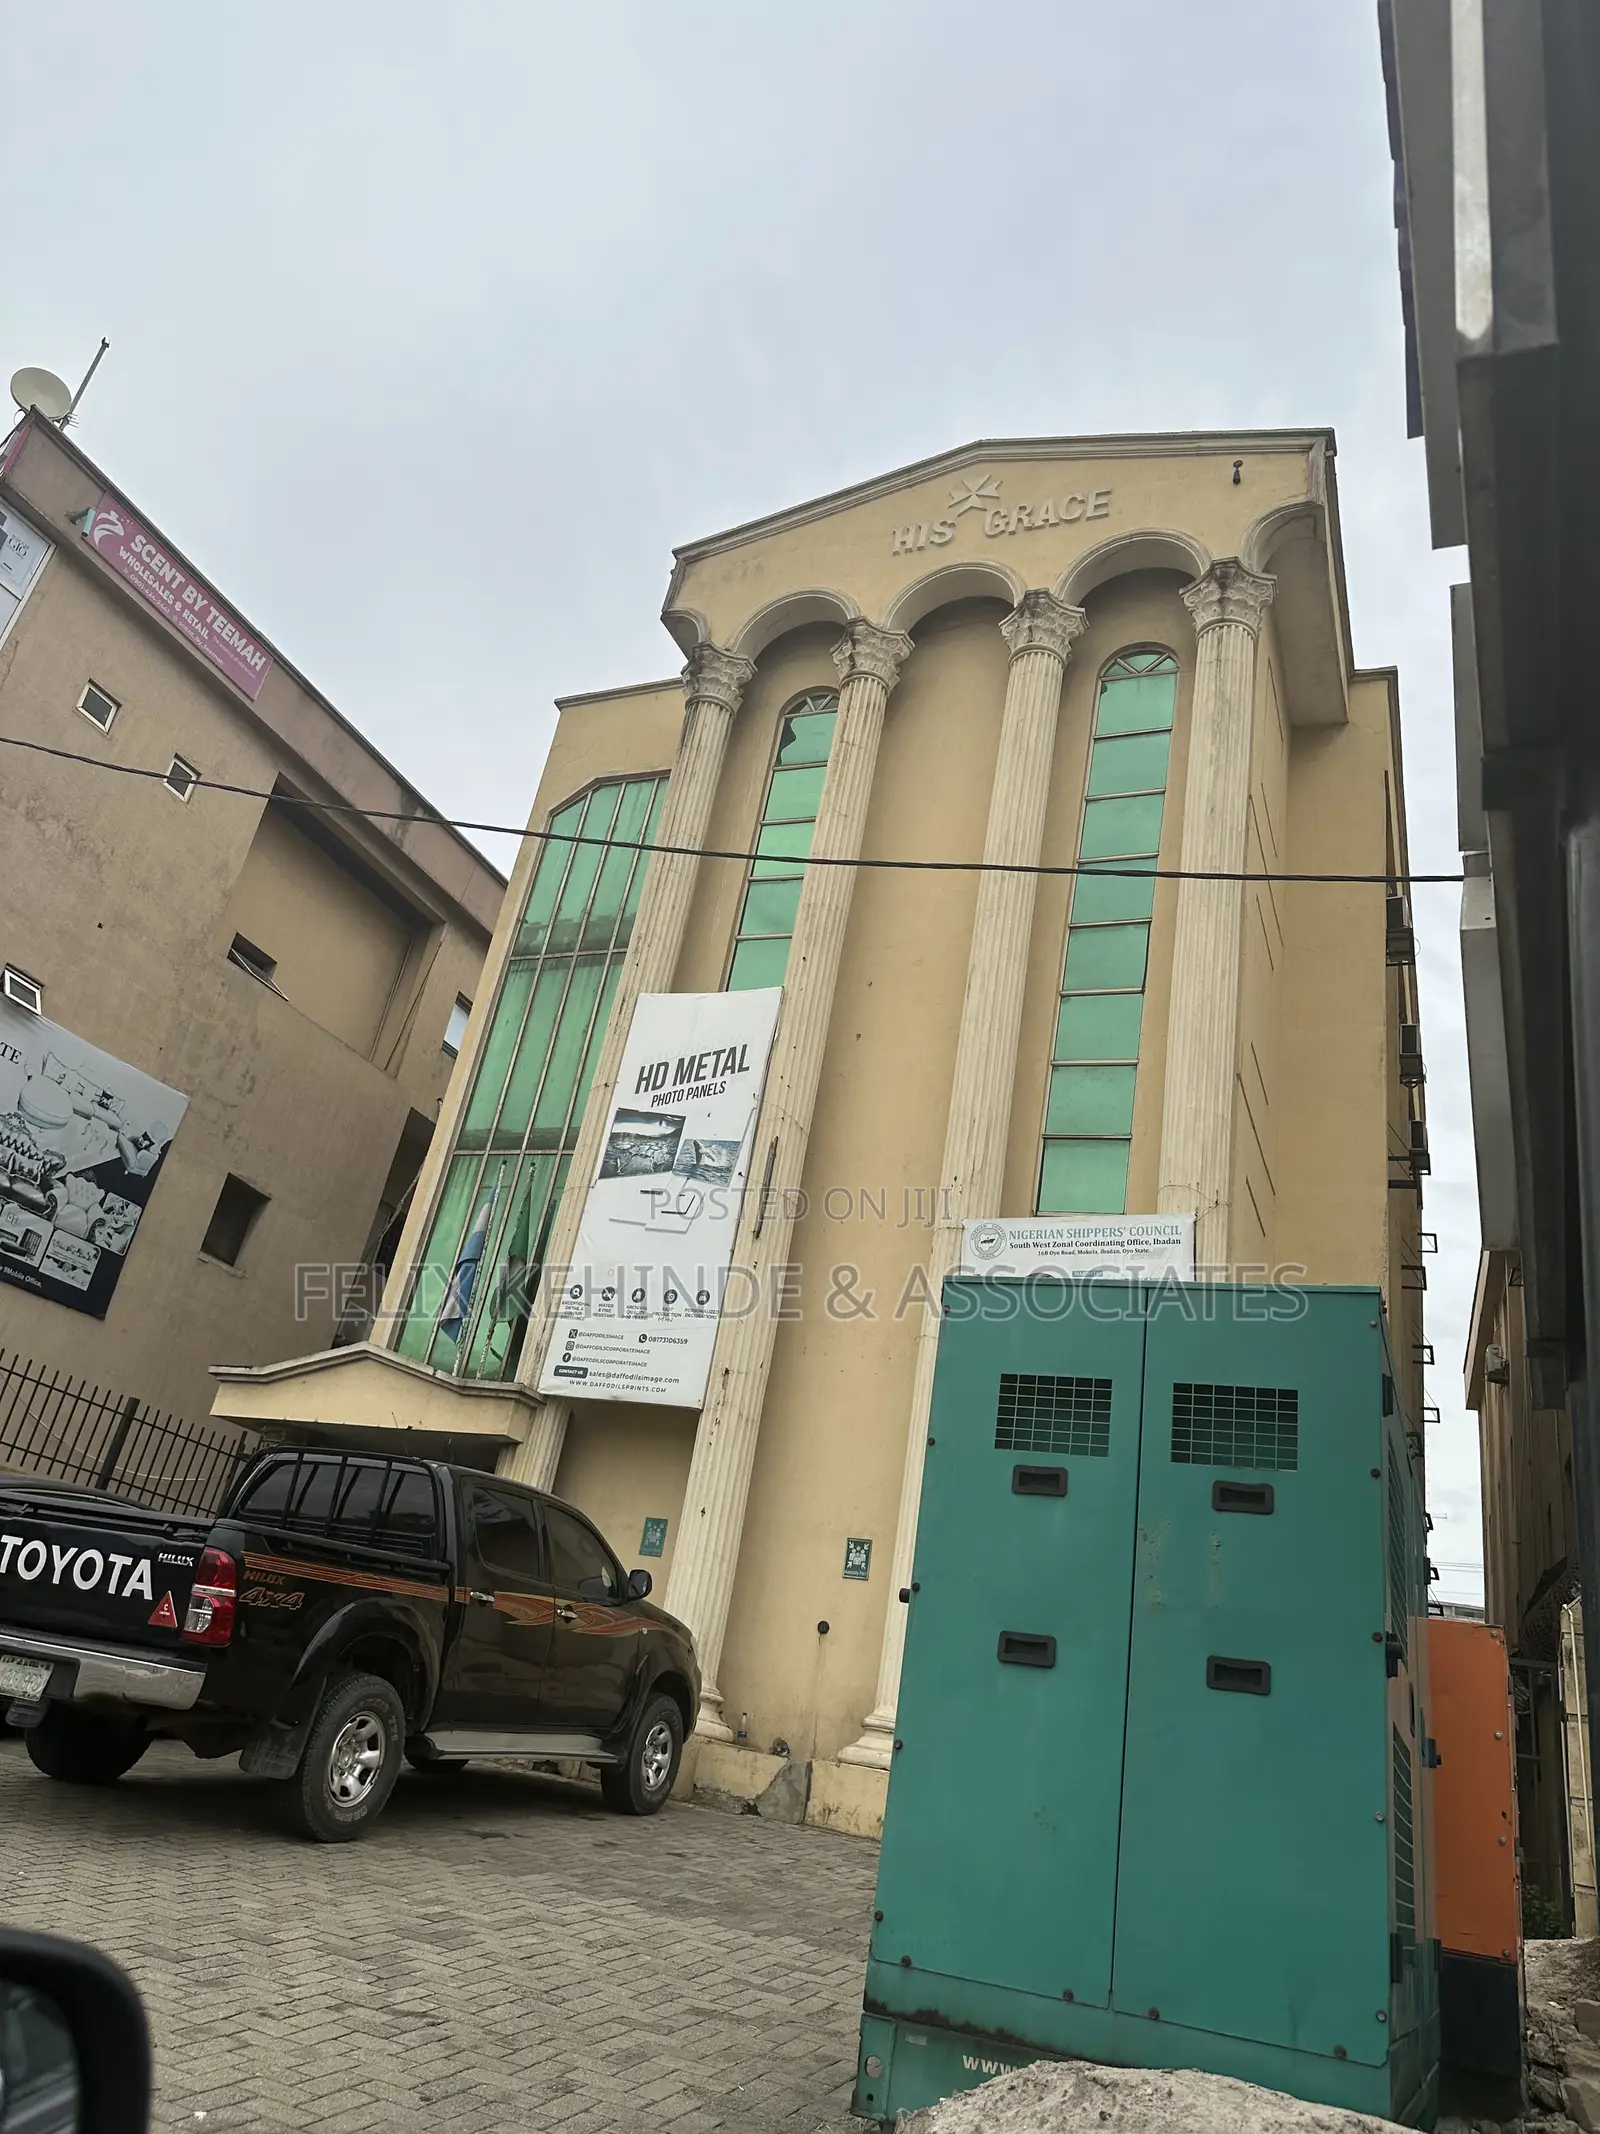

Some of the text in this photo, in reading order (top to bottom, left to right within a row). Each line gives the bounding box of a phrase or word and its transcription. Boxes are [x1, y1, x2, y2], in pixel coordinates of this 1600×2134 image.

[892, 488, 1113, 556] HIS GRACE
[118, 546, 209, 640] WHOLESALES & RETAIL
[130, 534, 267, 673] SCENT BY TEEMAH
[634, 1043, 750, 1095] HD METAL
[650, 1080, 727, 1108] PHOTO PANELS
[1008, 1229, 1065, 1241] NIGERIAN
[1129, 1225, 1182, 1237] COUNCIL
[1009, 1237, 1182, 1249] South West Zonal Coordinating Office, Ibadan
[588, 1370, 680, 1384] sales@daffodilsimage.com
[0, 1535, 153, 1601] TOYOTA
[158, 1552, 195, 1568] HILUX
[243, 1570, 286, 1586] HILUX
